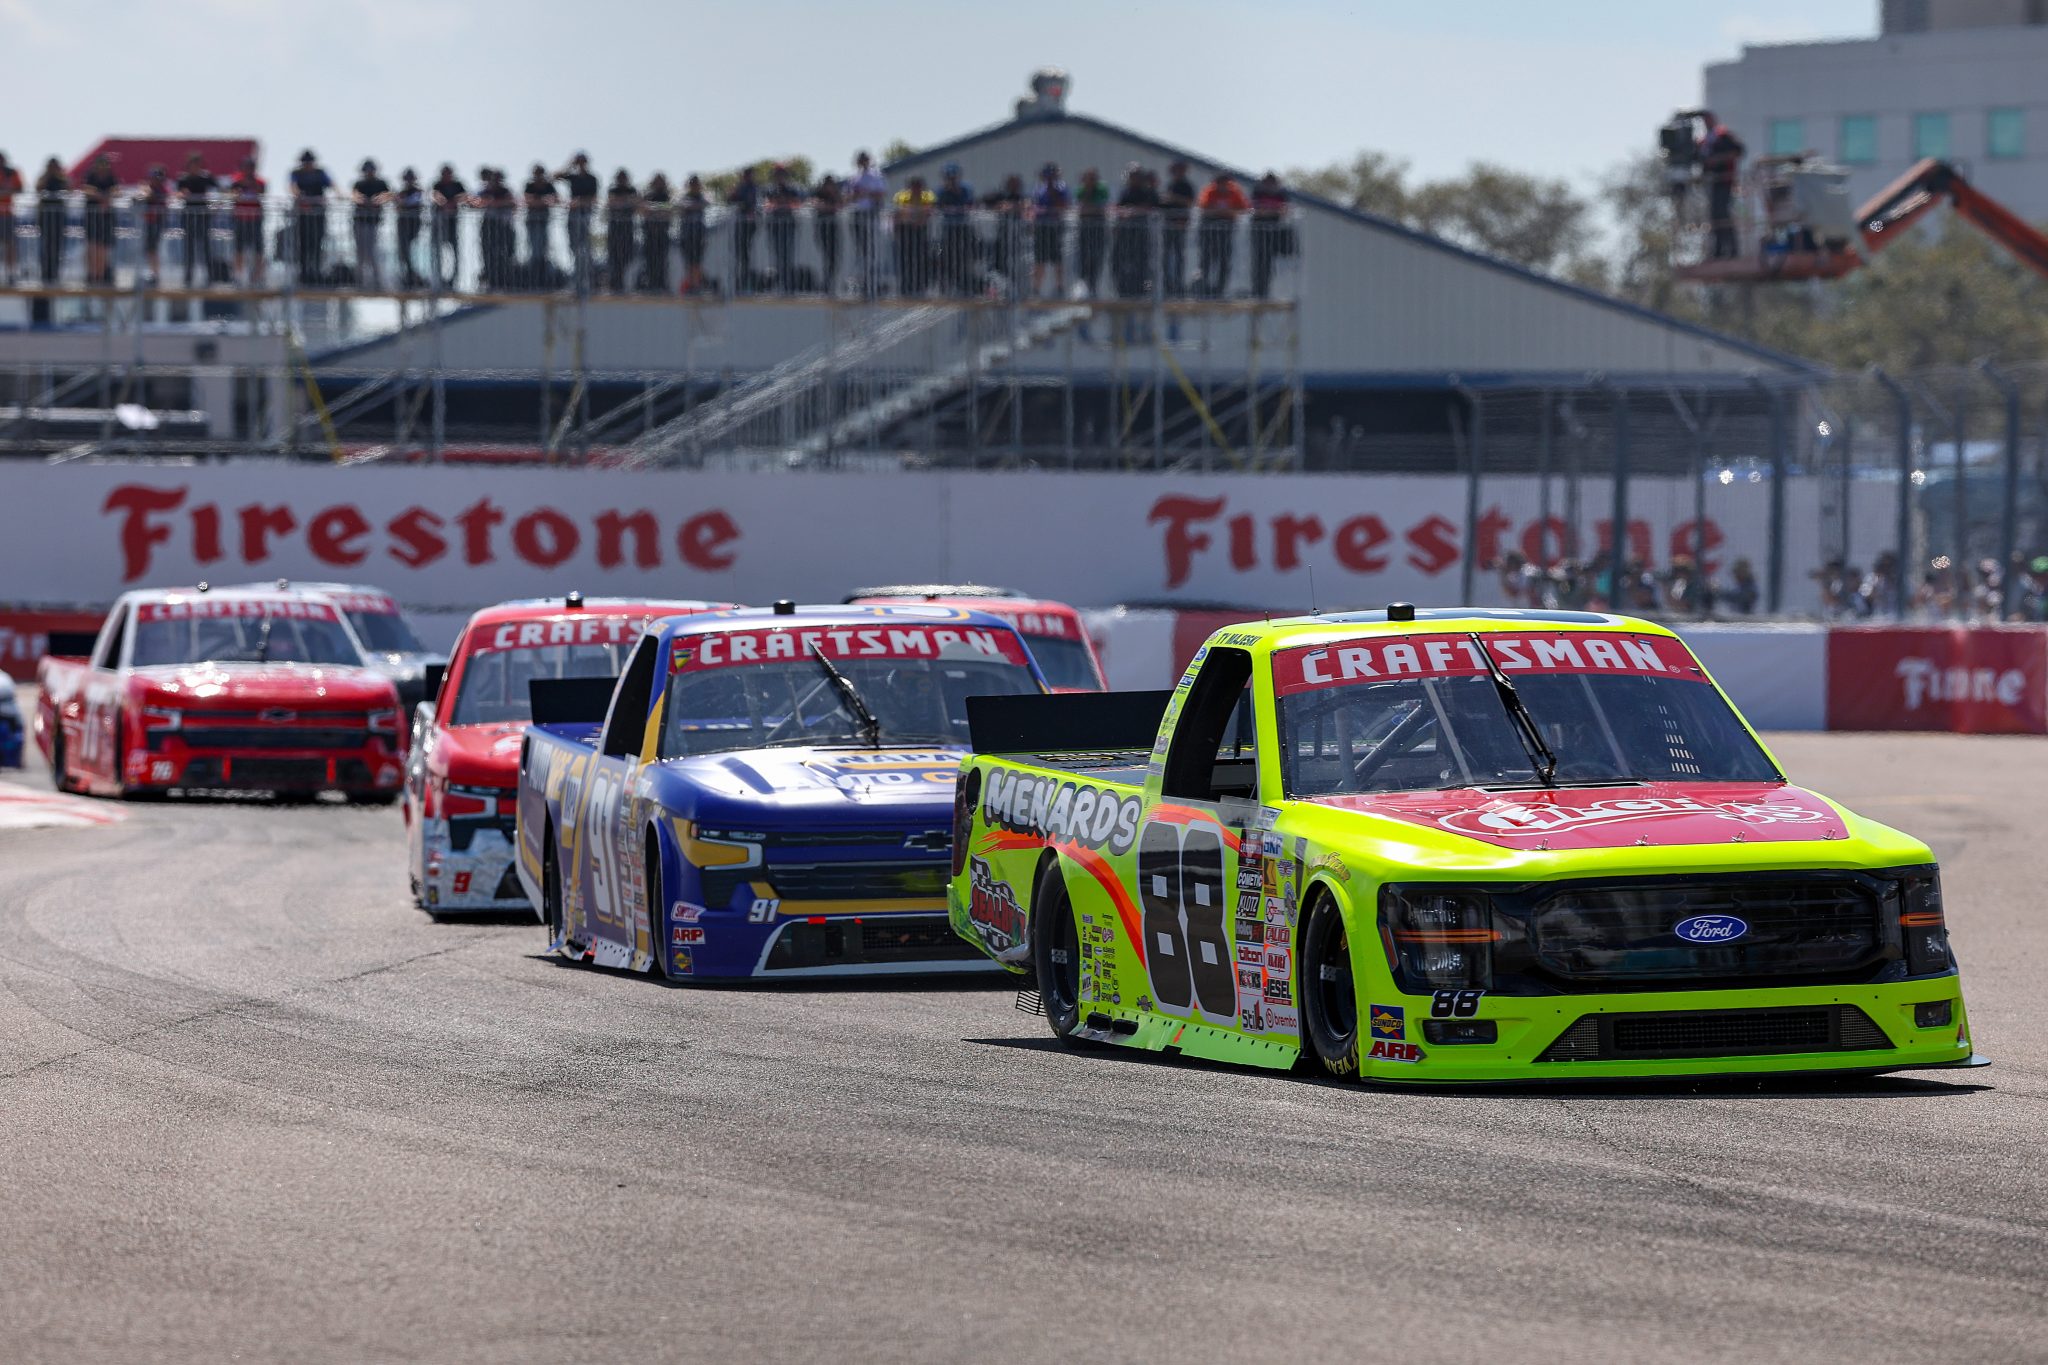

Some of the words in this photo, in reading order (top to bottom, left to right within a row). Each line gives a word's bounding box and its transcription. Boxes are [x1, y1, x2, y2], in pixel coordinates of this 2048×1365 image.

[103, 484, 741, 581] Firestone
[1149, 493, 1724, 588] Firestone
[700, 630, 1000, 665] CRAFTSMAN
[1302, 638, 1667, 685] CRAFTSMAN
[985, 770, 1142, 849] MENARDS
[453, 871, 473, 894] 9
[1238, 872, 1263, 888] COMETIC
[749, 899, 779, 922] 91
[1239, 895, 1259, 912] KLOTZ
[1137, 820, 1238, 1021] 88
[1689, 919, 1734, 938] Ford
[673, 929, 703, 941] ARP
[1266, 927, 1290, 943] CALICO
[1238, 945, 1263, 964] tilton
[1264, 979, 1292, 999] JESEL
[1431, 989, 1487, 1019] 88
[1274, 1013, 1297, 1028] brembo
[1371, 1018, 1403, 1029] SUNOCO
